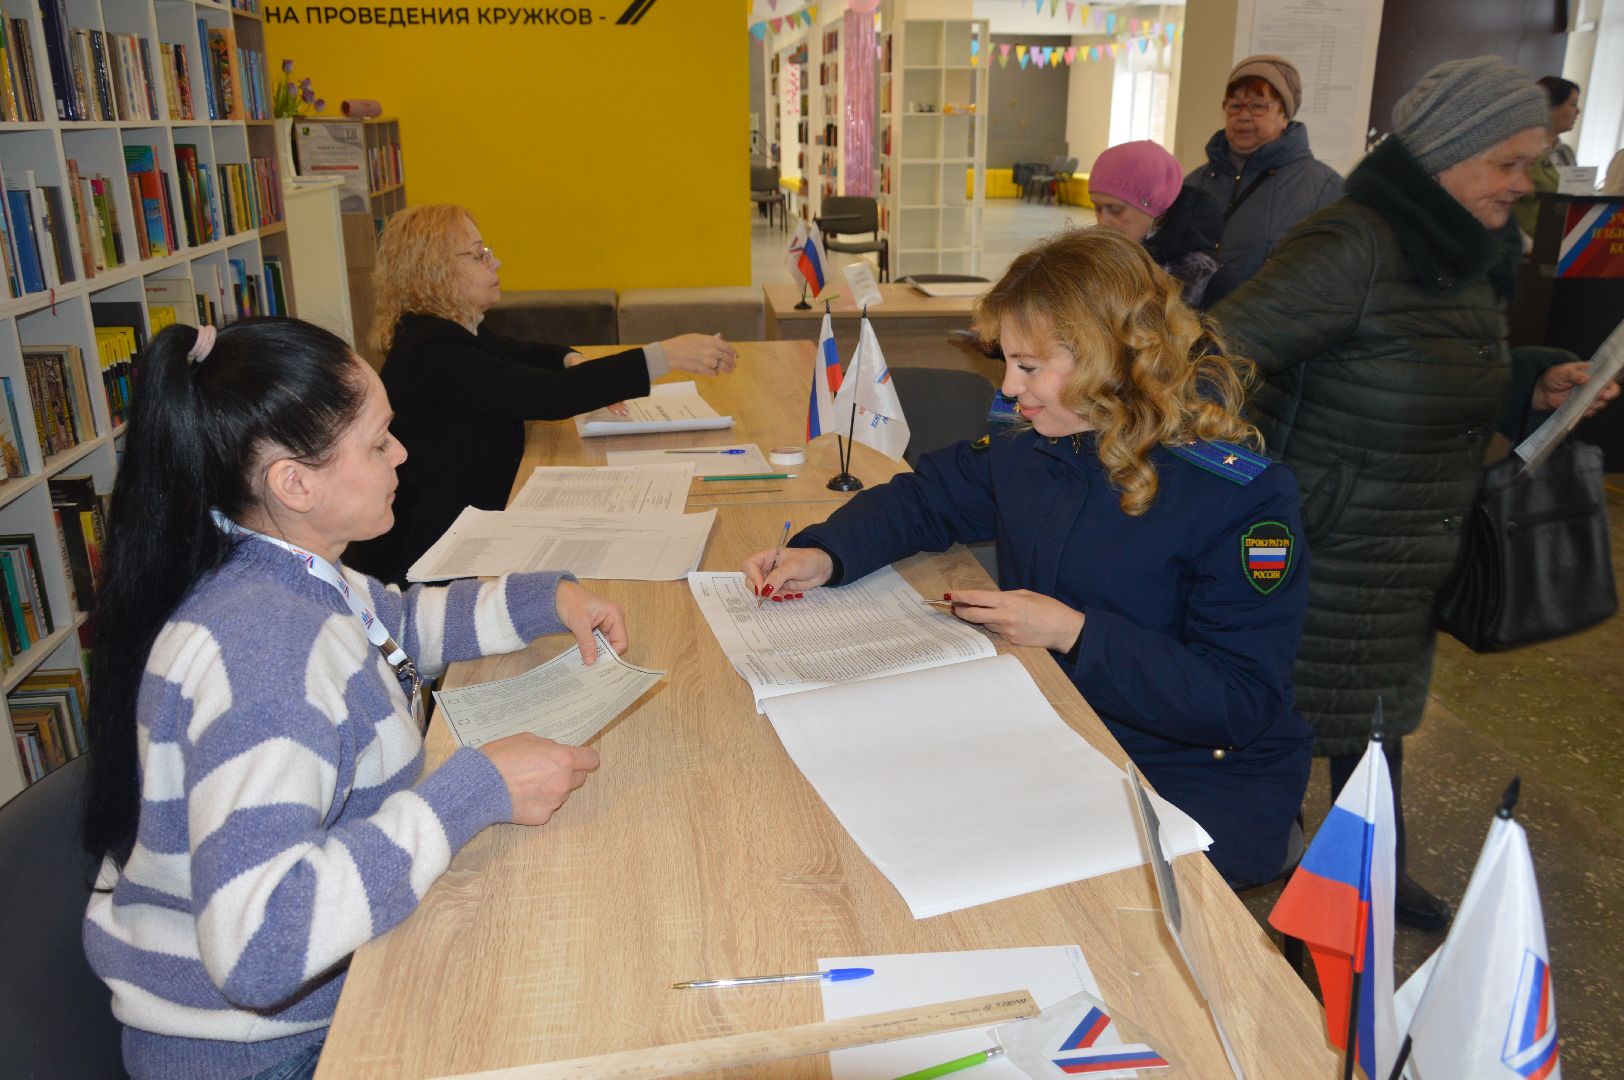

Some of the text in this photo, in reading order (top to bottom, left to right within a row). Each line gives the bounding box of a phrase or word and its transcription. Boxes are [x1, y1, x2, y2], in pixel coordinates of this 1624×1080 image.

[265, 6, 299, 24] НА
[306, 6, 470, 28] ПРОВЕДЕНИЯ
[477, 7, 593, 25] КРУЖКОВ
[1253, 570, 1281, 579] РОССИИ
